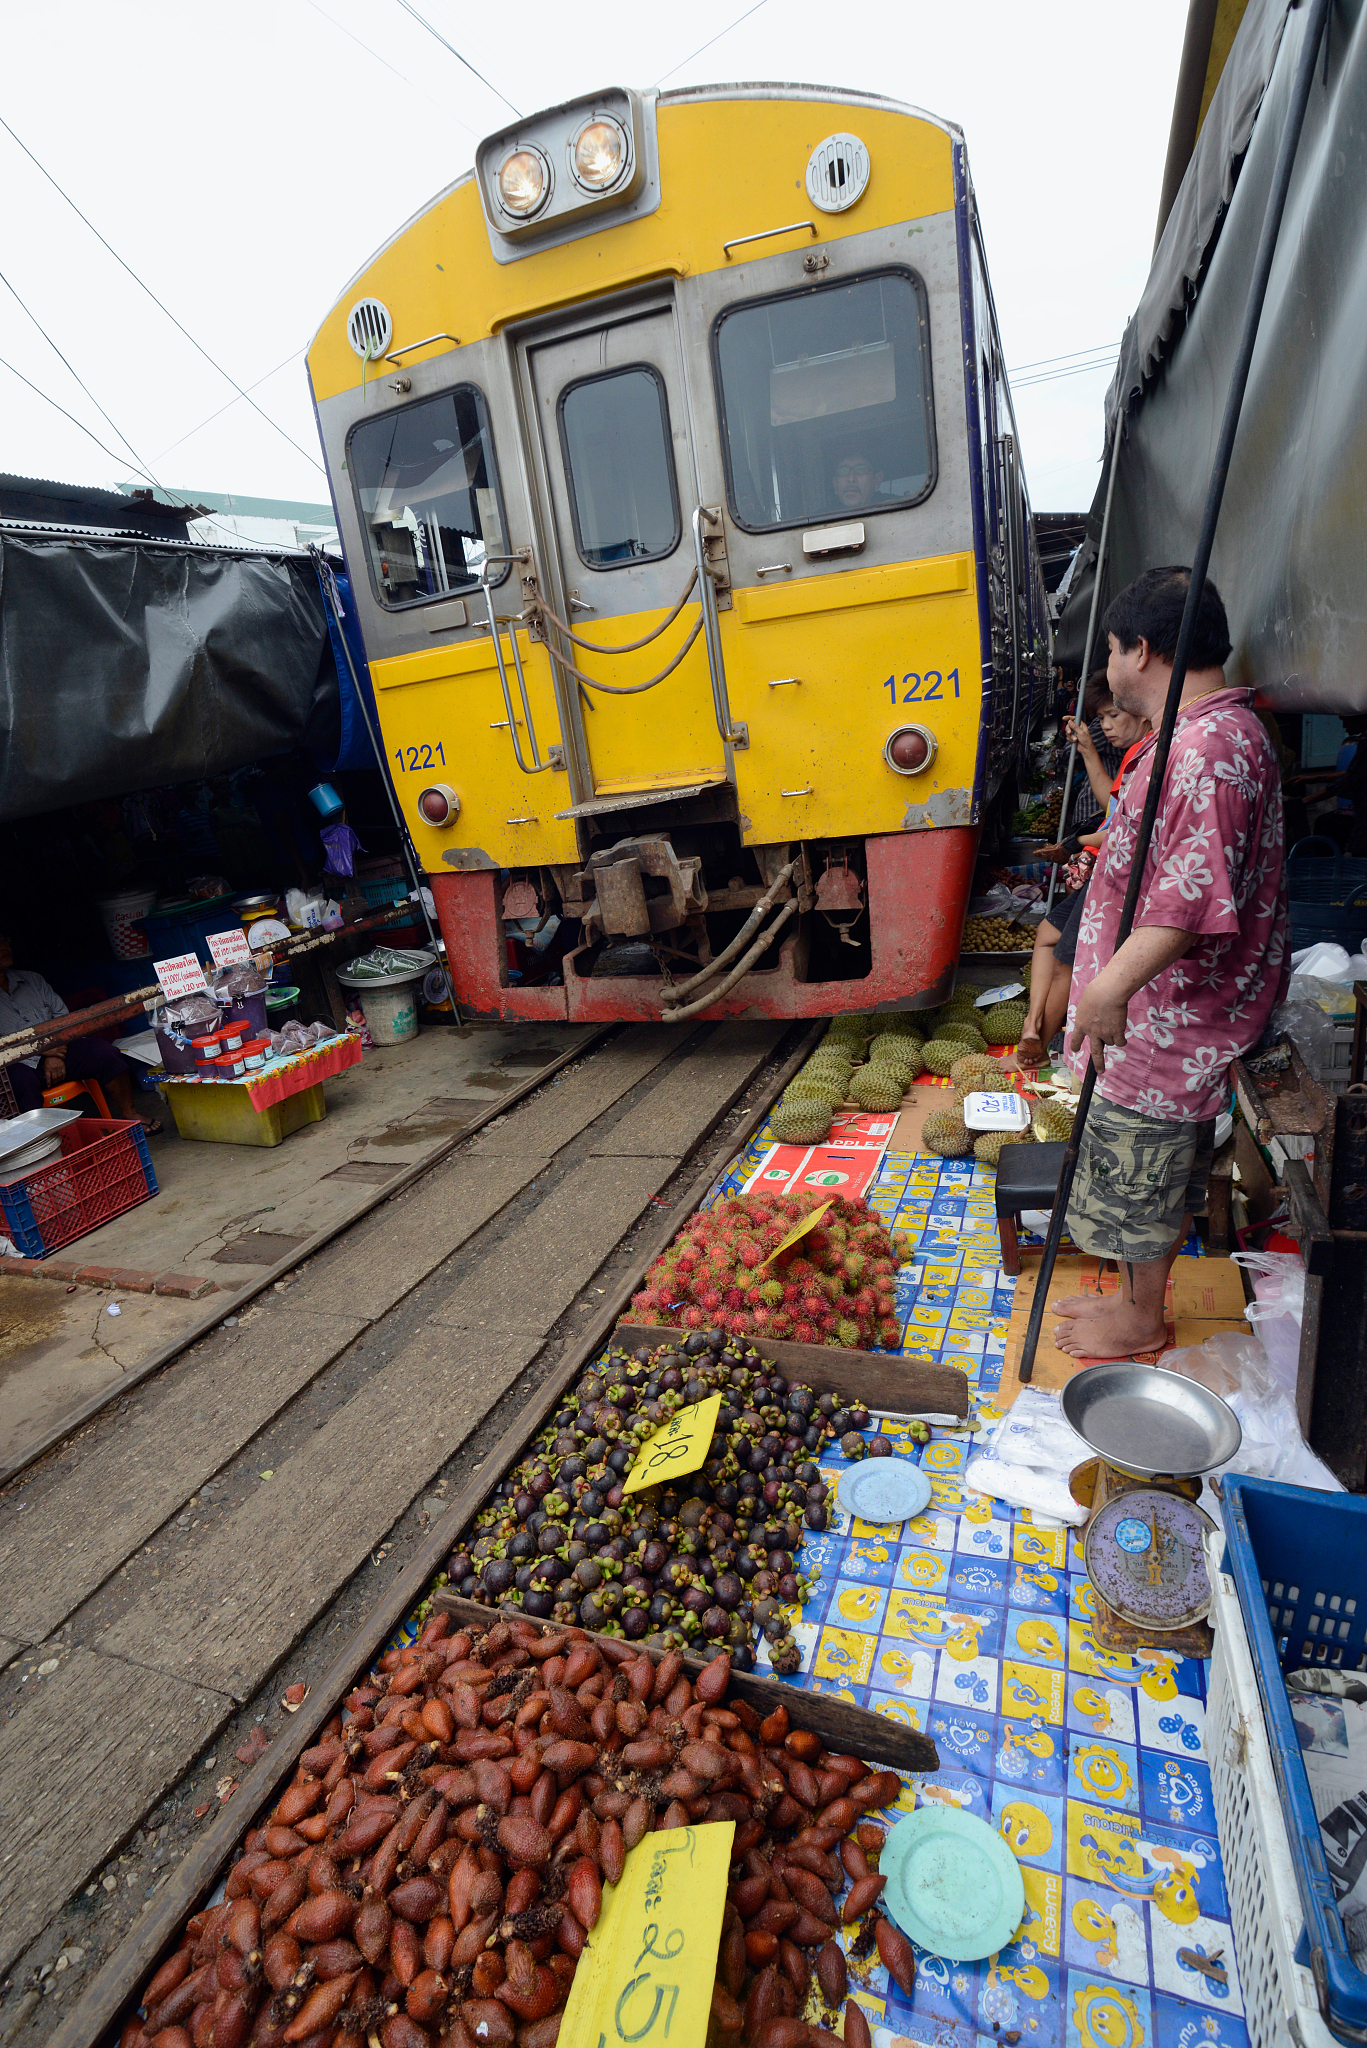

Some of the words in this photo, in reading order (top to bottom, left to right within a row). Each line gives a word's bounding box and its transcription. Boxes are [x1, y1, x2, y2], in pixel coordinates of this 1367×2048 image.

[883, 668, 960, 704] 1221
[395, 741, 446, 772] 1221
[168, 973, 181, 986] 100%
[183, 982, 195, 992] 120
[856, 1636, 875, 1682] tweety
[1048, 1673, 1061, 1723] tweety
[1043, 1877, 1058, 1952] tweety
